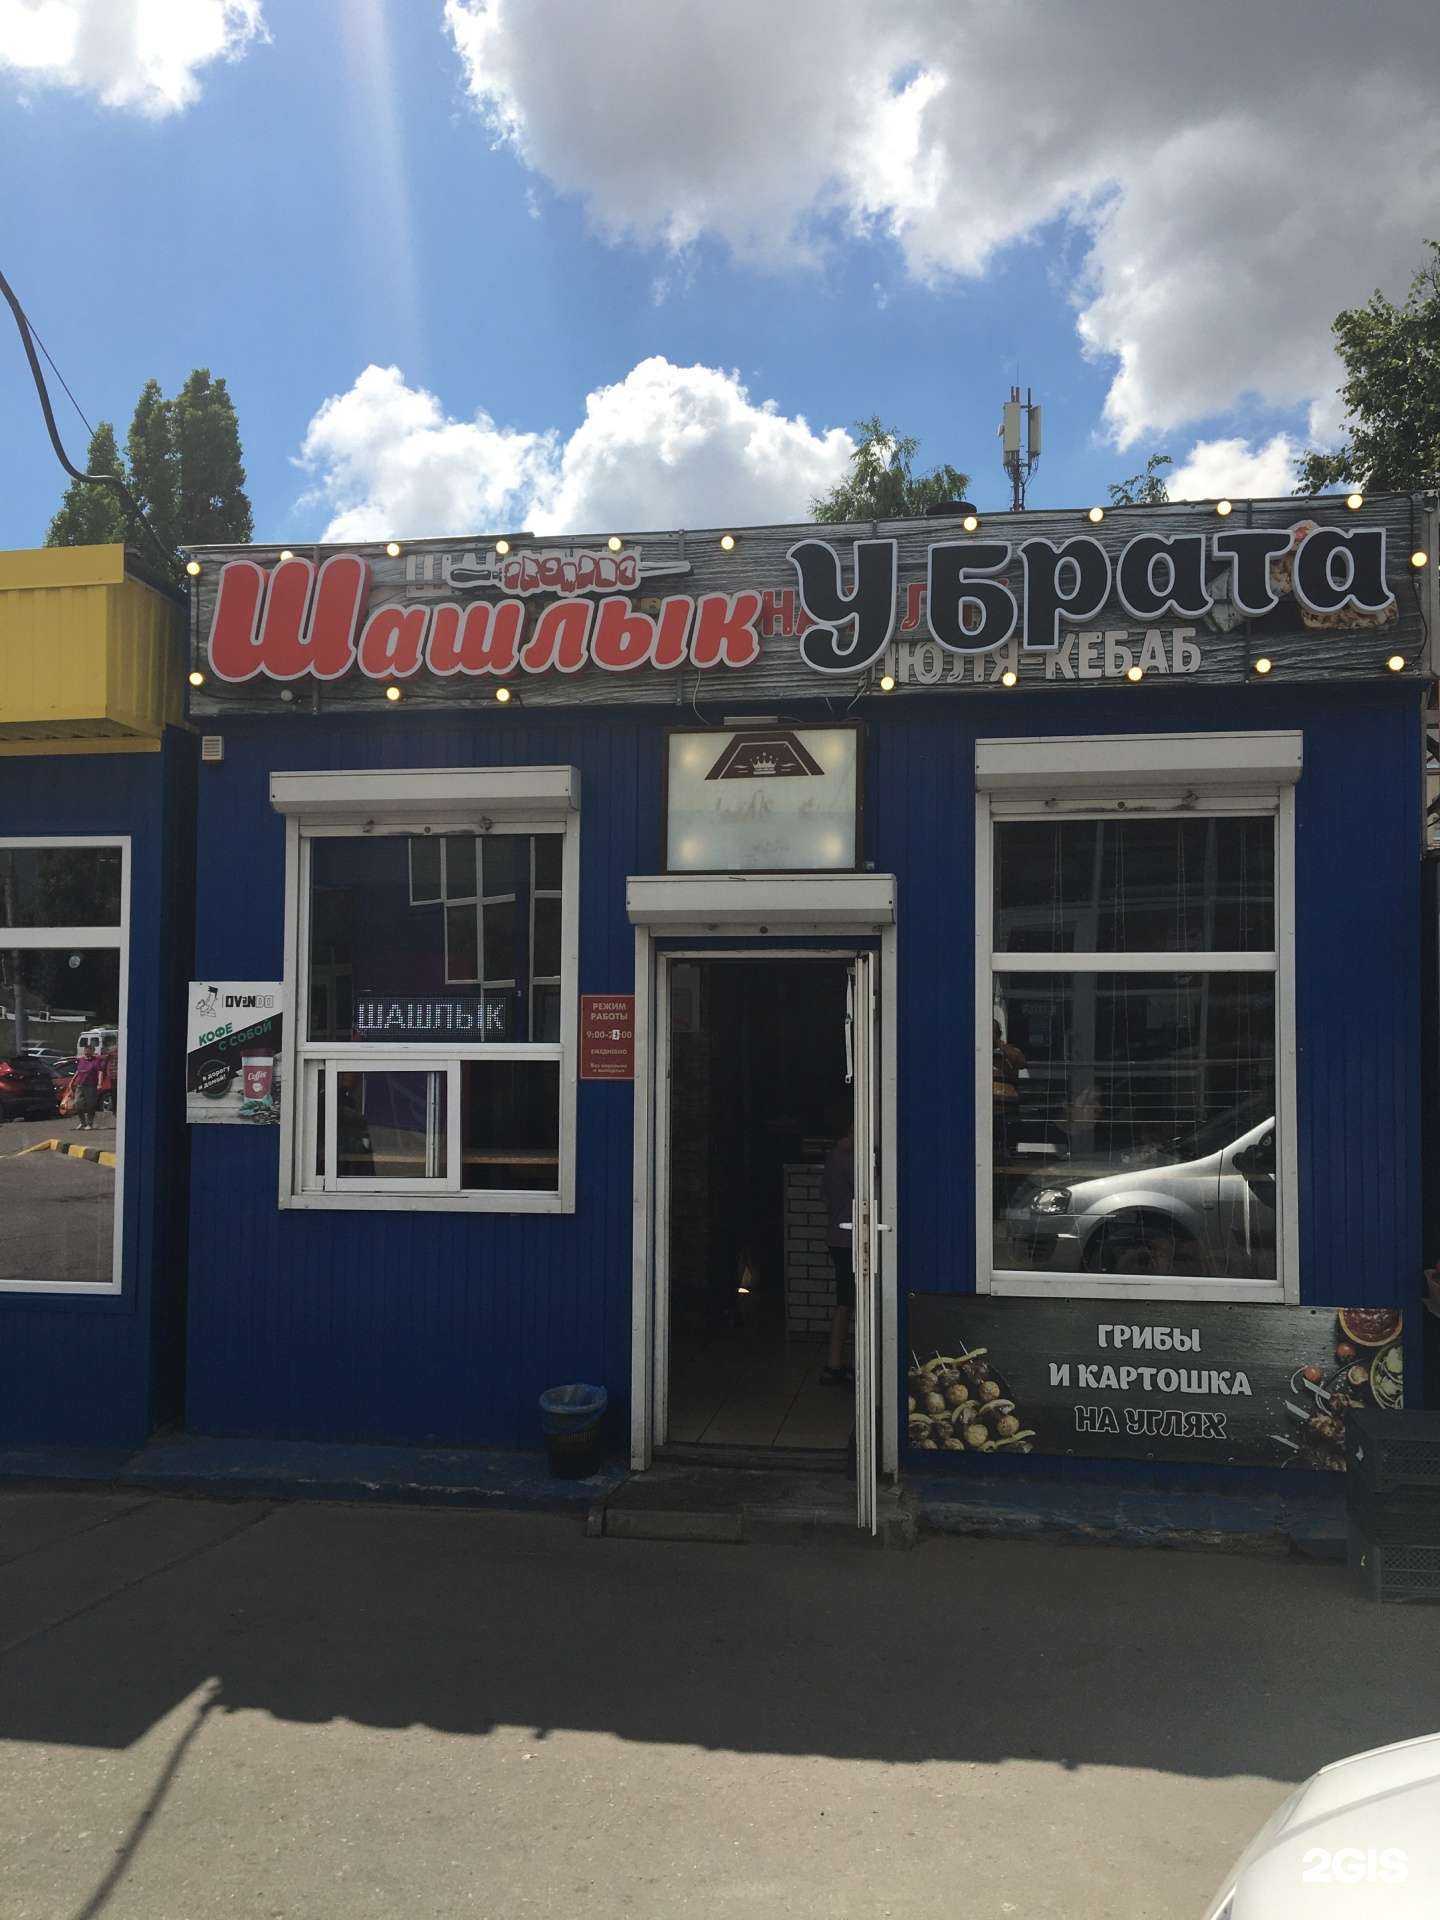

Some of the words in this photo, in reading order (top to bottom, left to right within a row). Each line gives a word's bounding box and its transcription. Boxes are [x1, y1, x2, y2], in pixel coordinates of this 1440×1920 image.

[207, 554, 763, 682] Шашлык
[786, 539, 898, 673] У
[591, 1012, 628, 1021] РАБОТЫ
[592, 1002, 627, 1011] РЕЖИМ
[198, 1022, 234, 1046] КОФЕ
[230, 1018, 273, 1047] СОБОЙ
[207, 1065, 231, 1080] дорогу
[1097, 1323, 1202, 1354] ГРИБЫ
[1048, 1362, 1071, 1388] И
[1078, 1363, 1253, 1397] КАРТОШКА
[1074, 1405, 1120, 1435] НА
[1125, 1409, 1228, 1440] УГЛЯХ
